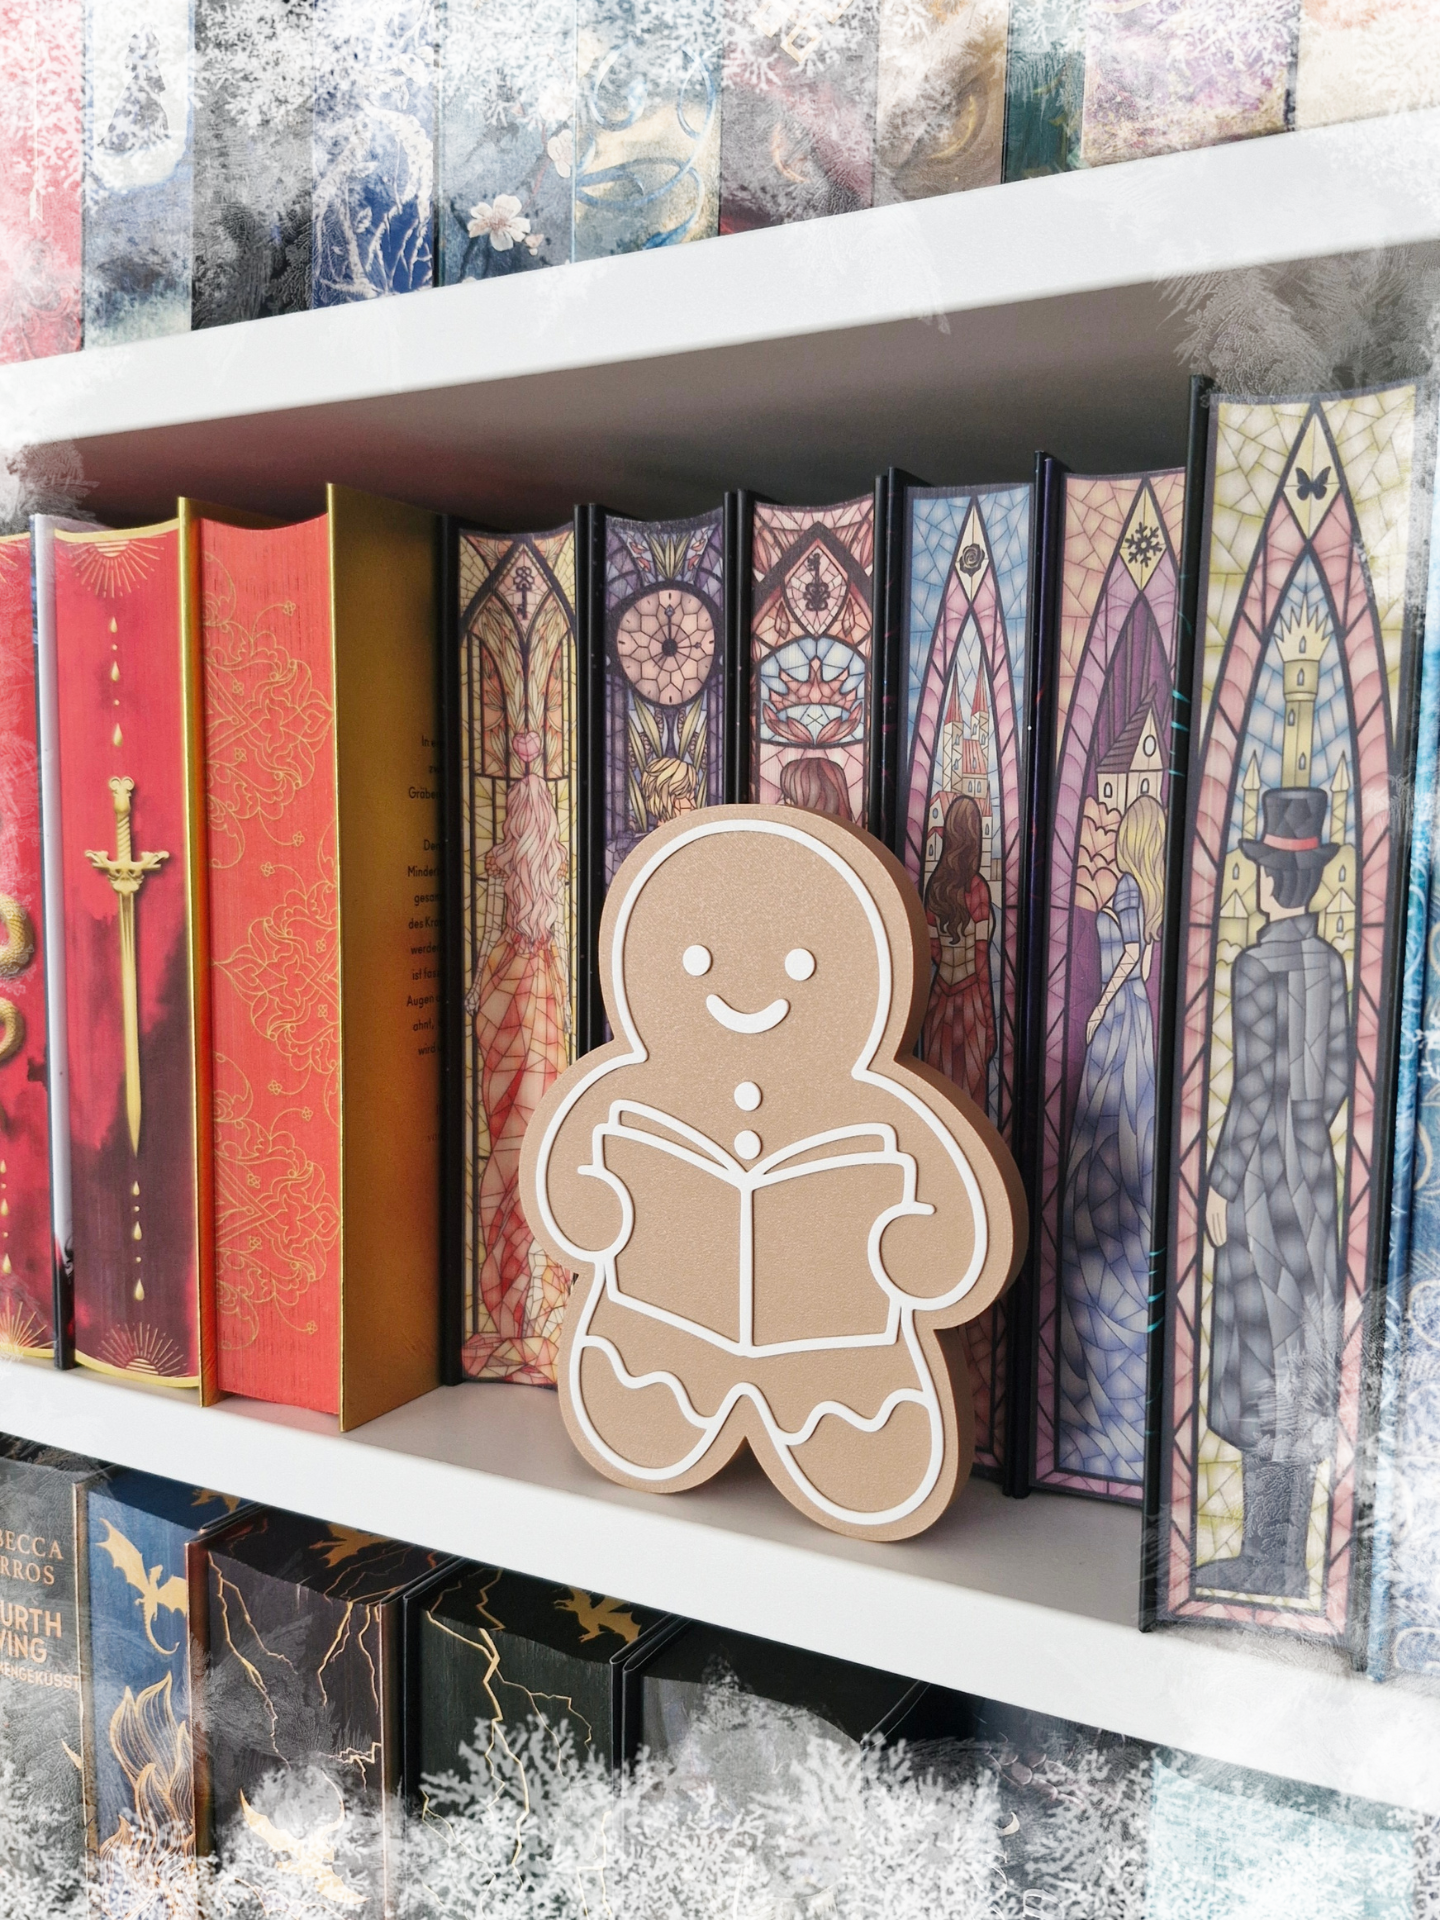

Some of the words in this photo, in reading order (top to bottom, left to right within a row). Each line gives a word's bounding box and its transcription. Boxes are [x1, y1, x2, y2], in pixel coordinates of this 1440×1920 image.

[408, 917, 424, 930] des
[406, 994, 434, 1009] Augen
[418, 1042, 436, 1055] wird
[0, 1661, 79, 1690] ENGEKÜSST
